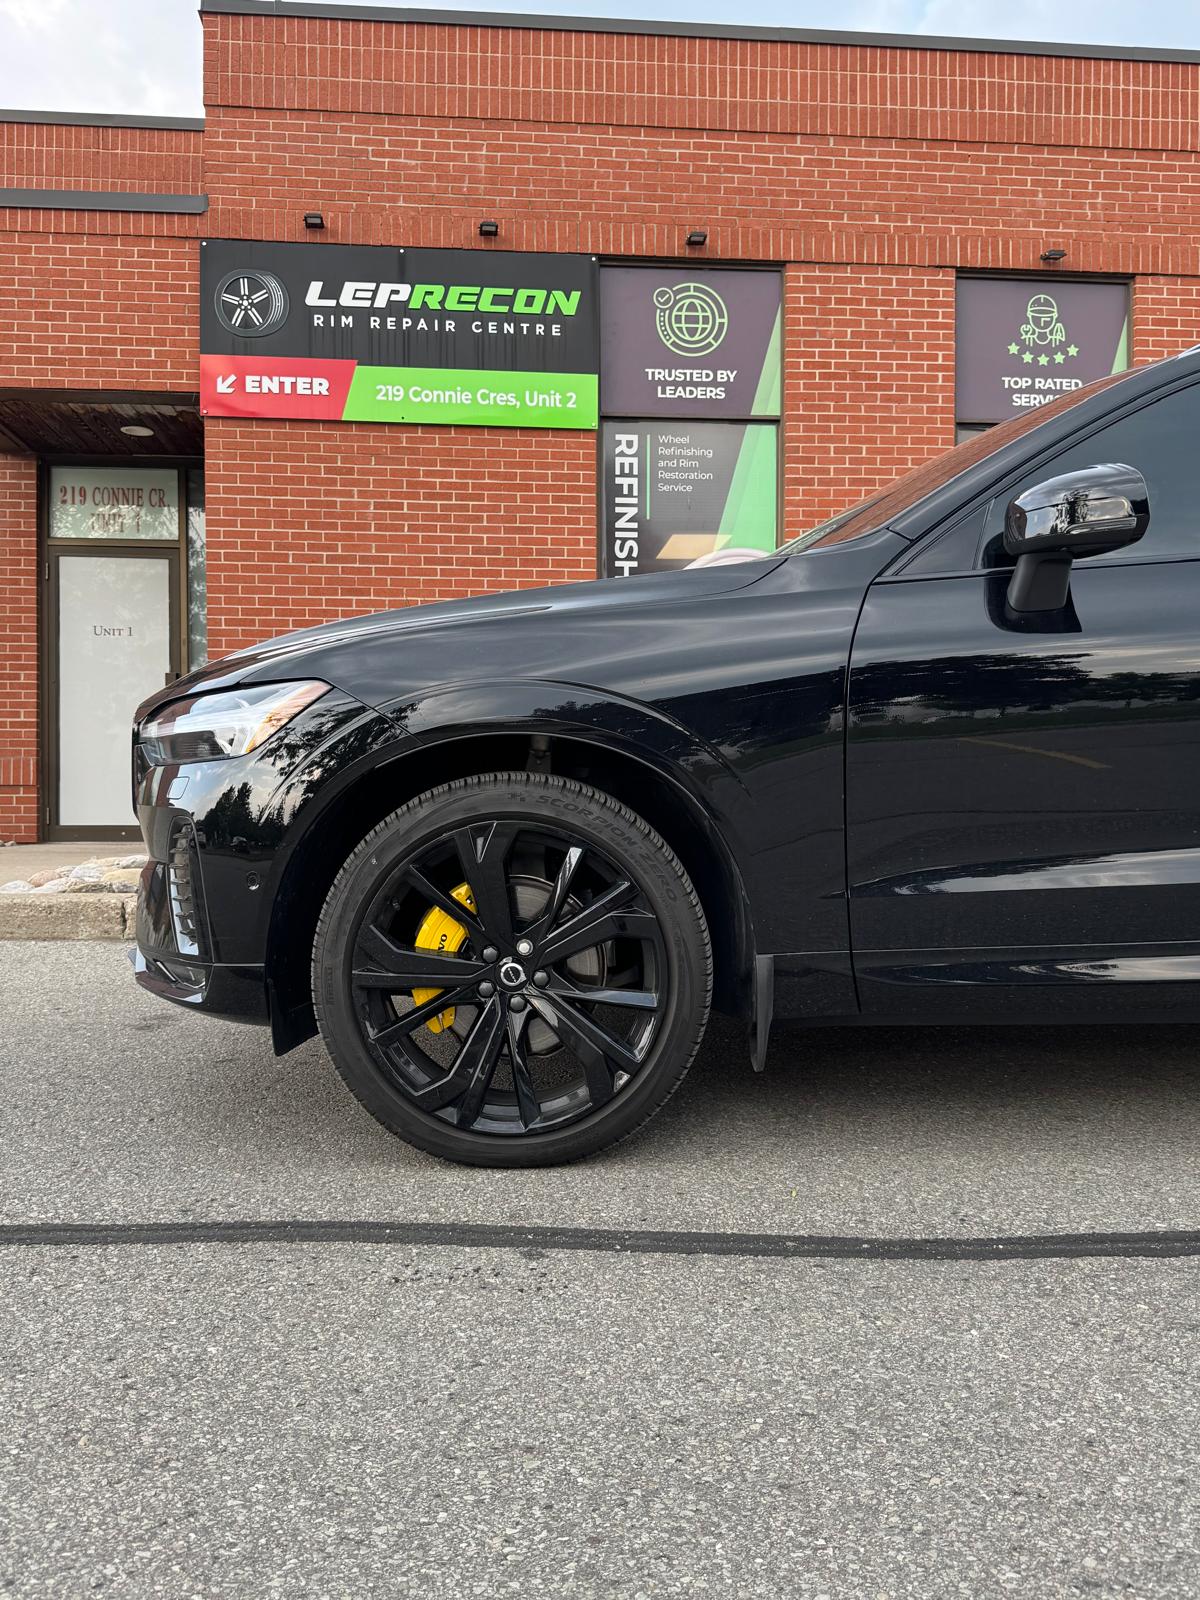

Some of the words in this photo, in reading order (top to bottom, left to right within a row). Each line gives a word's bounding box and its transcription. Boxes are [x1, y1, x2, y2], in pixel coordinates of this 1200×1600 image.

[304, 280, 582, 316] LEPRECON
[313, 314, 354, 328] RIM
[371, 316, 456, 332] REPAIR
[472, 321, 562, 336] CENTRE
[645, 368, 714, 383] TRUSTED
[717, 370, 737, 383] BY
[245, 375, 330, 396] ENTER
[1001, 376, 1032, 389] TOP
[1034, 378, 1083, 391] RATED
[376, 385, 404, 401] 219
[408, 386, 472, 405] Connie
[476, 388, 520, 409] Cres,
[525, 390, 561, 408] Unit
[565, 392, 577, 408] 2
[657, 385, 726, 400] LEADERS
[1012, 393, 1060, 407] SERVI
[658, 435, 690, 444] Wheel
[658, 446, 713, 458] Refinishing
[658, 459, 677, 468] and
[679, 459, 699, 468] Rim
[658, 471, 713, 480] Restoration
[658, 483, 693, 492] Service
[60, 485, 87, 506] 219
[92, 486, 145, 507] CONNIE
[148, 488, 171, 508] CR.
[127, 626, 134, 637] 1
